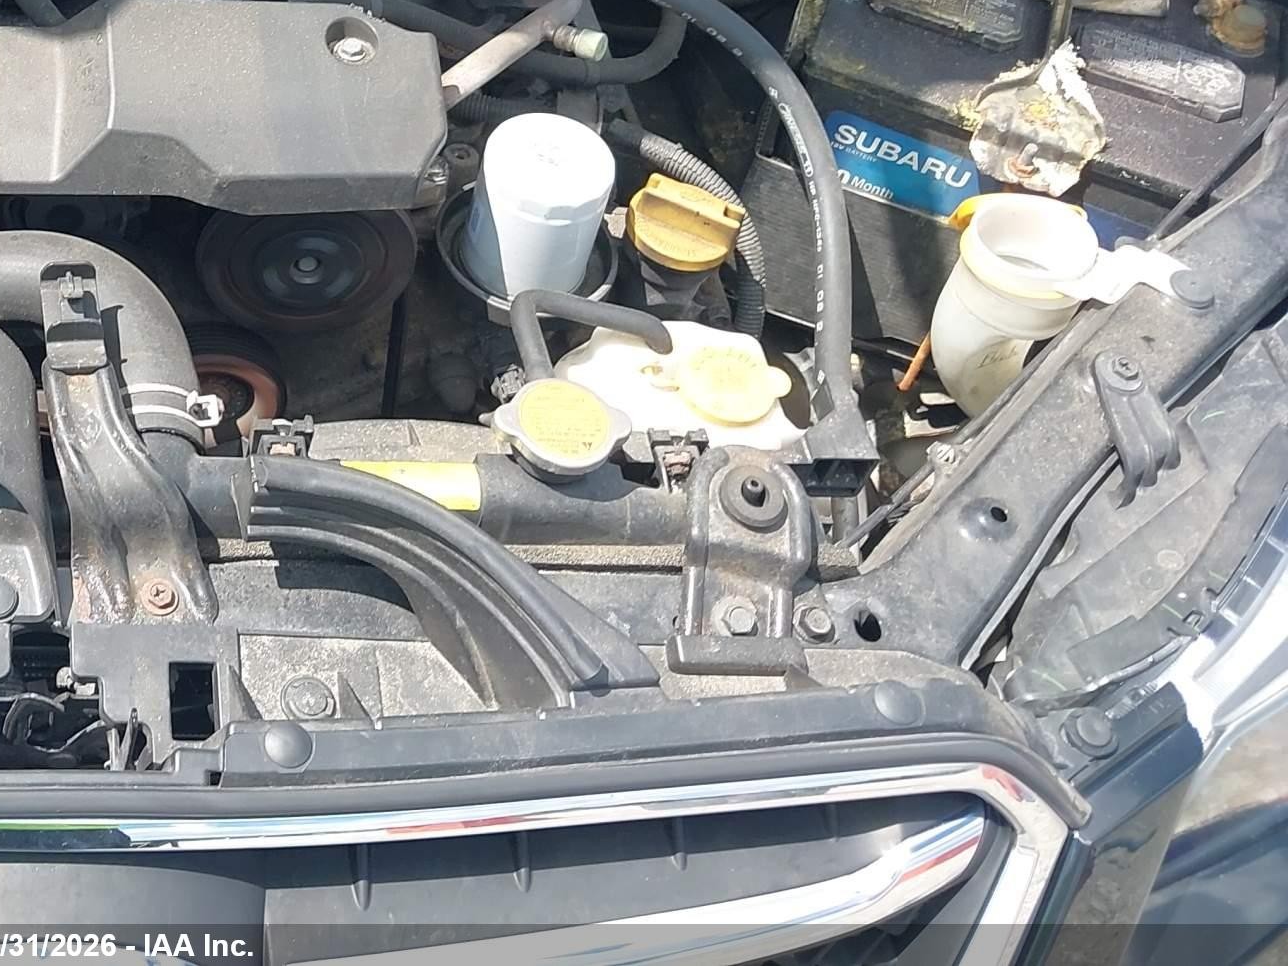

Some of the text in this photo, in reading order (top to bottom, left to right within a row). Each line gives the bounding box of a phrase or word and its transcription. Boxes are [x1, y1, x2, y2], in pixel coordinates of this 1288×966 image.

[834, 124, 972, 188] SUBARU
[845, 147, 878, 163] BATTERY
[850, 175, 895, 200] Month
